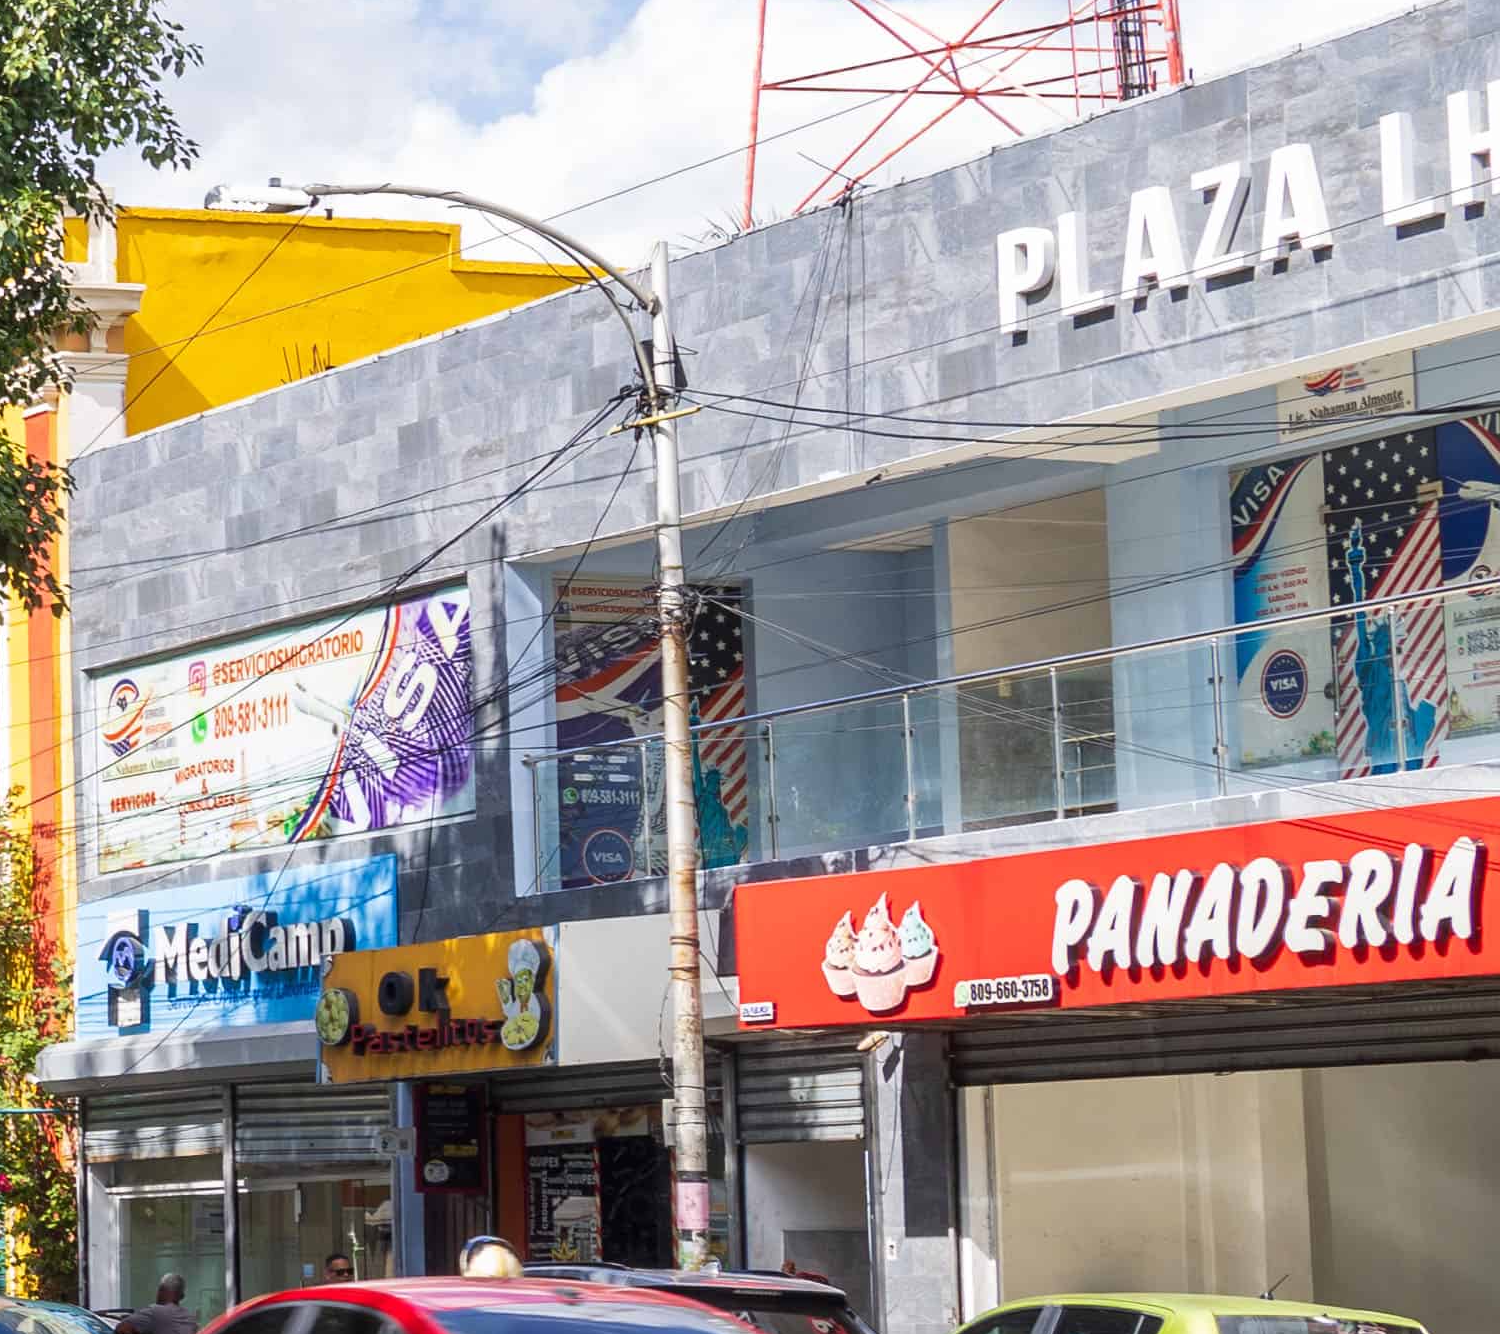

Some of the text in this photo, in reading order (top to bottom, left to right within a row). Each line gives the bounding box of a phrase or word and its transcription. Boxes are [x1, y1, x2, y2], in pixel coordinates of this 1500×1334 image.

[996, 142, 1333, 334] PLAZA
[1232, 465, 1286, 527] VISA
[212, 629, 364, 686] @SERVICIOSMIGRATORIO
[1269, 675, 1299, 693] VISA
[214, 691, 289, 740] 809-581-3111
[329, 597, 471, 830] VISA
[175, 758, 235, 784] MIGRATORIOS
[110, 791, 156, 814] SERVICIOS
[591, 851, 625, 864] VISA
[1051, 836, 1480, 976] PANADERIA
[154, 907, 346, 984] MediCamp
[970, 978, 1049, 1001] 809-660-3758
[351, 1018, 496, 1055] Pastelitos
